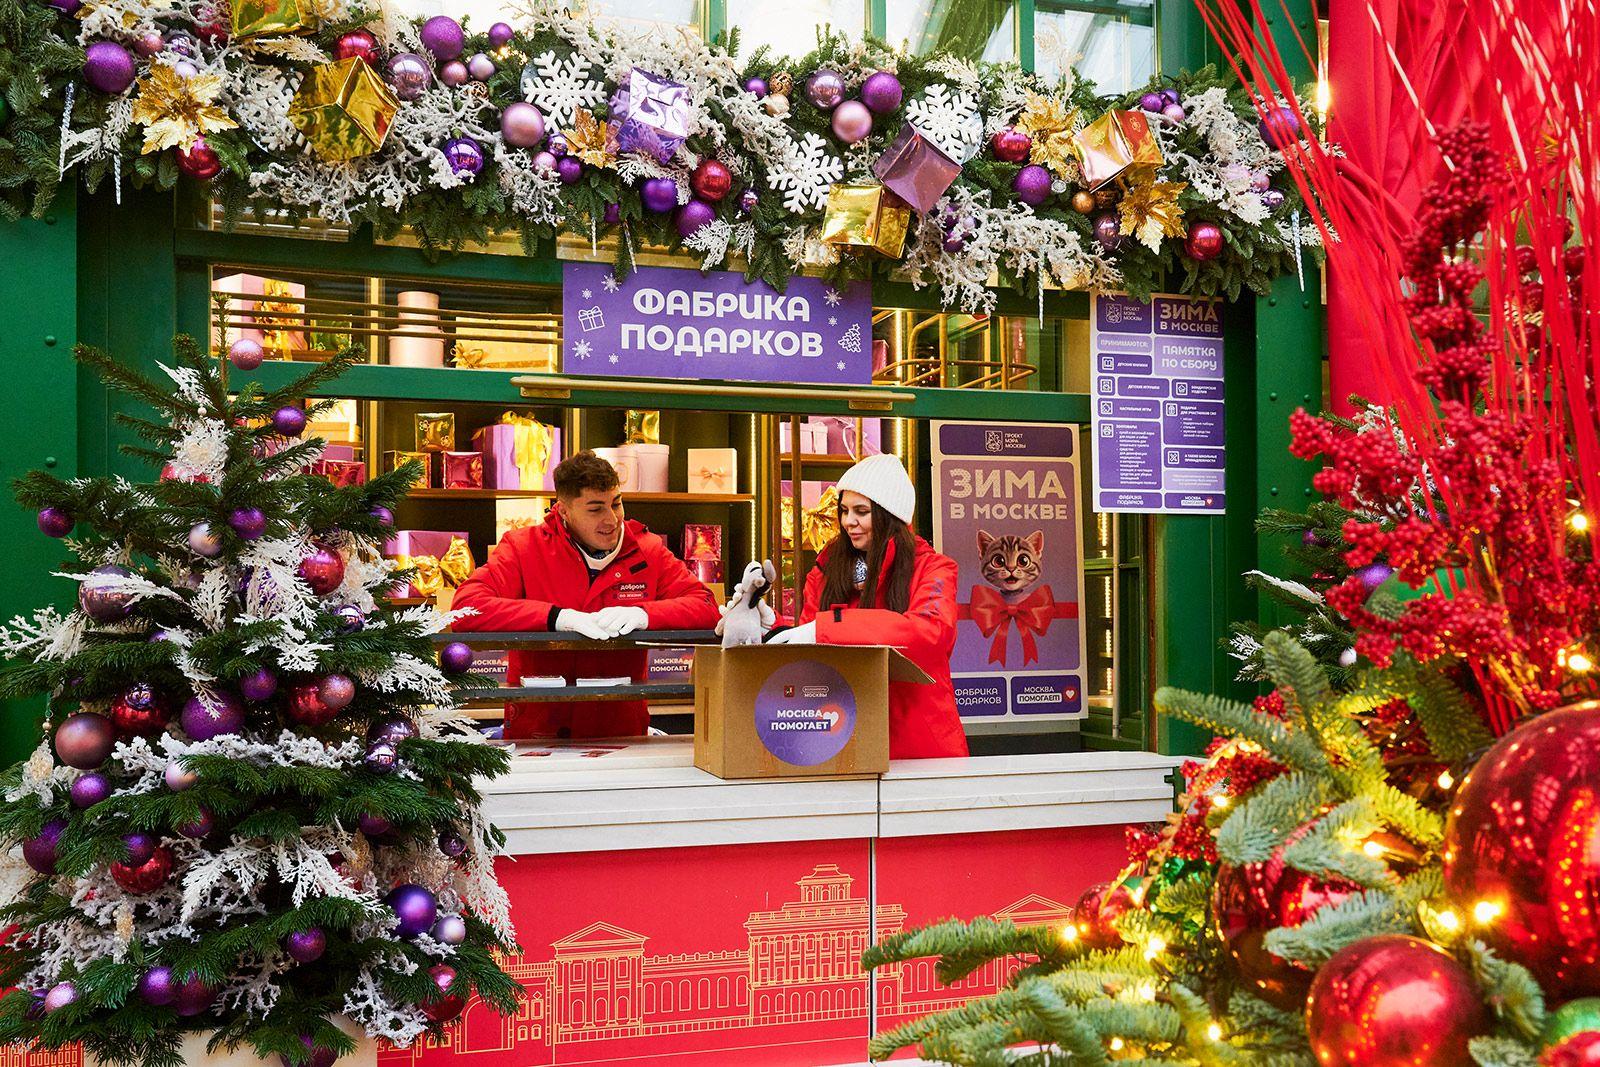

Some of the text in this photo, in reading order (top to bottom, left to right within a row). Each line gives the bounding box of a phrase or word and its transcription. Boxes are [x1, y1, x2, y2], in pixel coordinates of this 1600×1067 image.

[632, 287, 811, 323] ФАБРИКА
[1160, 303, 1219, 322] ЗИМА
[1160, 321, 1219, 333] В МОСКВЕ
[620, 323, 824, 358] ПОДАРКОВ
[1162, 345, 1217, 357] ПАМЯТКА
[1161, 358, 1217, 371] ПО СБОРУ
[949, 468, 1067, 499] ЗИМА
[950, 503, 1068, 520] В МОСКВЕ
[955, 688, 999, 696] ФАБРИКА
[1019, 694, 1061, 702] ПОМОГАЕТ
[776, 709, 823, 719] МОСКВА
[771, 721, 829, 731] ПОМОГАЕТ
